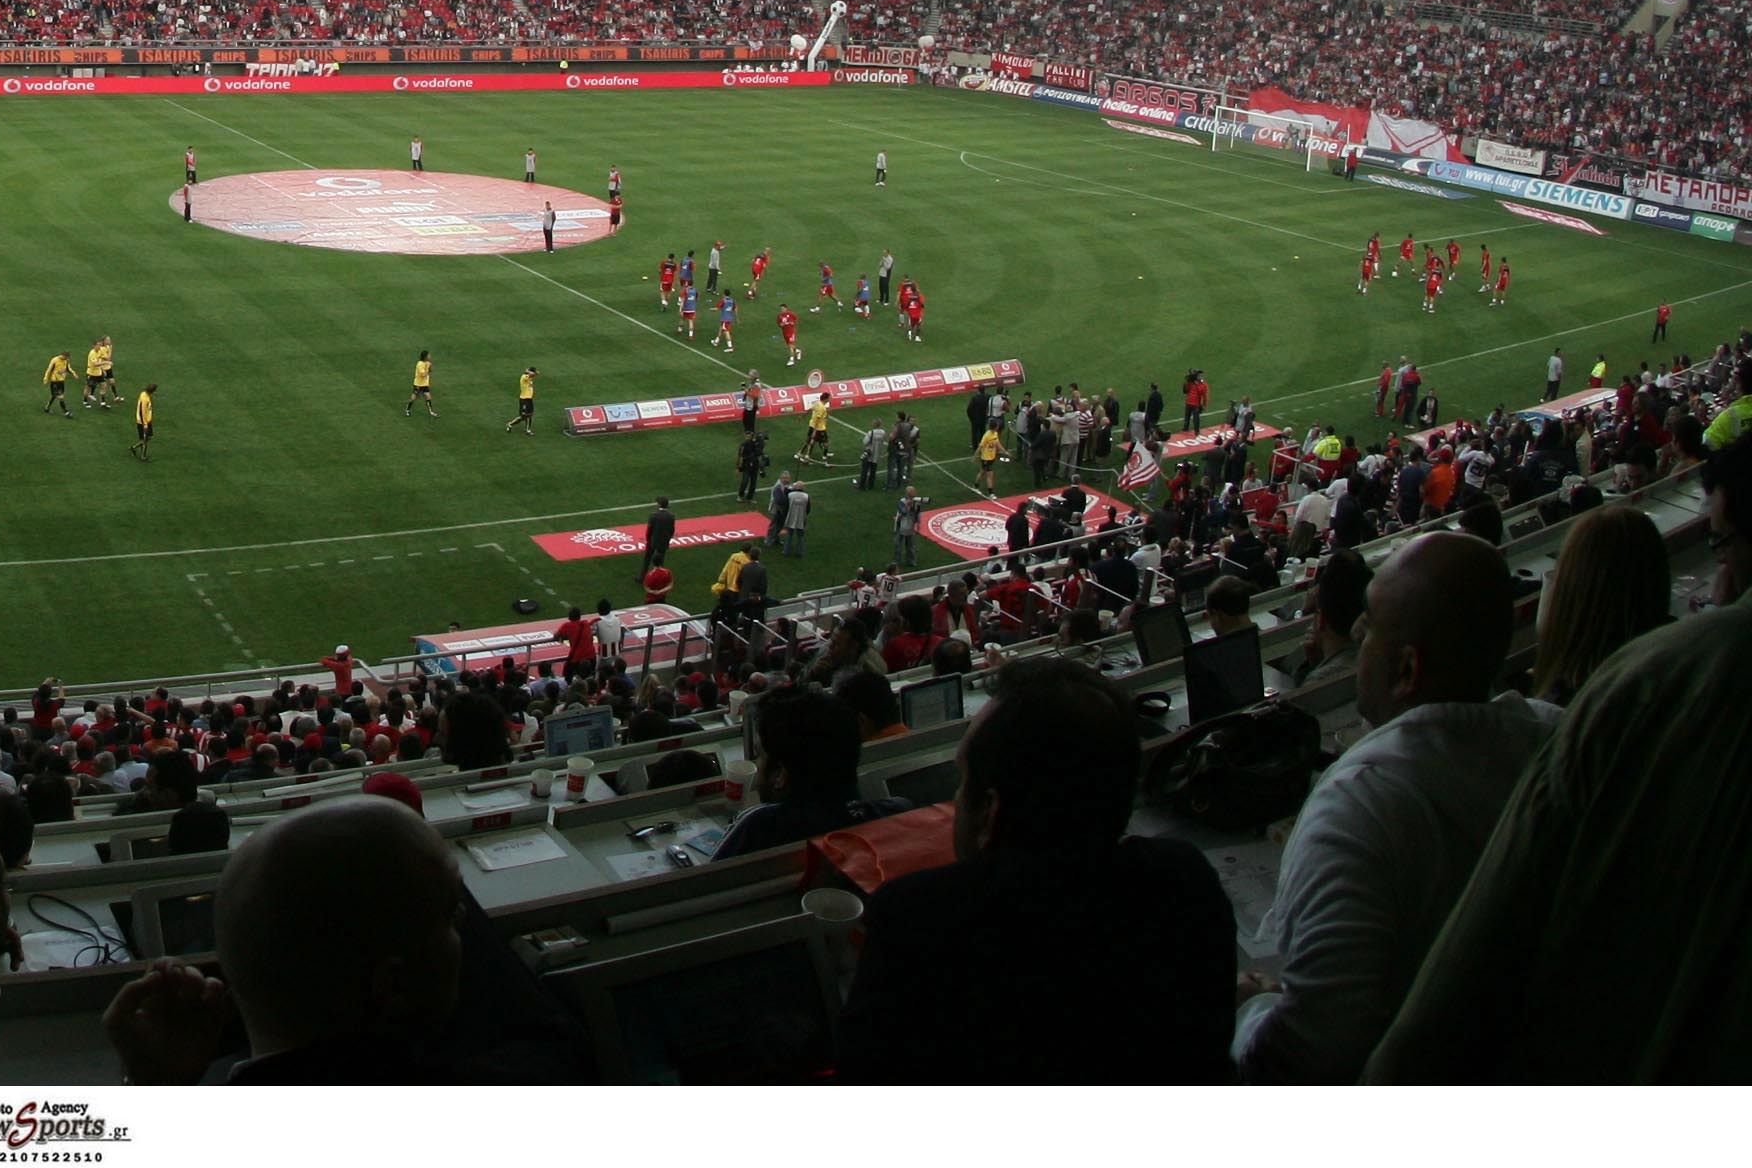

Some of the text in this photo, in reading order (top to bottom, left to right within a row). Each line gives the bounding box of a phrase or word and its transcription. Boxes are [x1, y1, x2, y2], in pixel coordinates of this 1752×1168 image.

[74, 51, 108, 63] CHIPS
[136, 49, 246, 63] TSAKIRIS CHIPS
[347, 50, 377, 61] CHIPS
[404, 48, 461, 61] TSAKIRIS
[527, 48, 579, 60] TSAKIRIS
[639, 48, 691, 59] TSAKIRIS
[992, 52, 1035, 68] KIMOLOS
[412, 78, 474, 89] vodafone
[583, 76, 640, 86] vodafone
[738, 74, 789, 84] vodafone
[846, 70, 909, 84] vodafone
[25, 79, 95, 91] vodafone
[224, 78, 291, 91] vodafone
[986, 77, 1033, 97] AMSTEL
[1112, 80, 1199, 113] ARGOS
[1103, 98, 1175, 121] hellas online
[1185, 114, 1246, 138] citibank
[1464, 167, 1526, 193] www.tui.gr
[1528, 180, 1625, 215] SIEMENS
[705, 397, 732, 412] AMSTEL
[618, 529, 756, 552] ΟΛΜΠΙΑΚΟΣ
